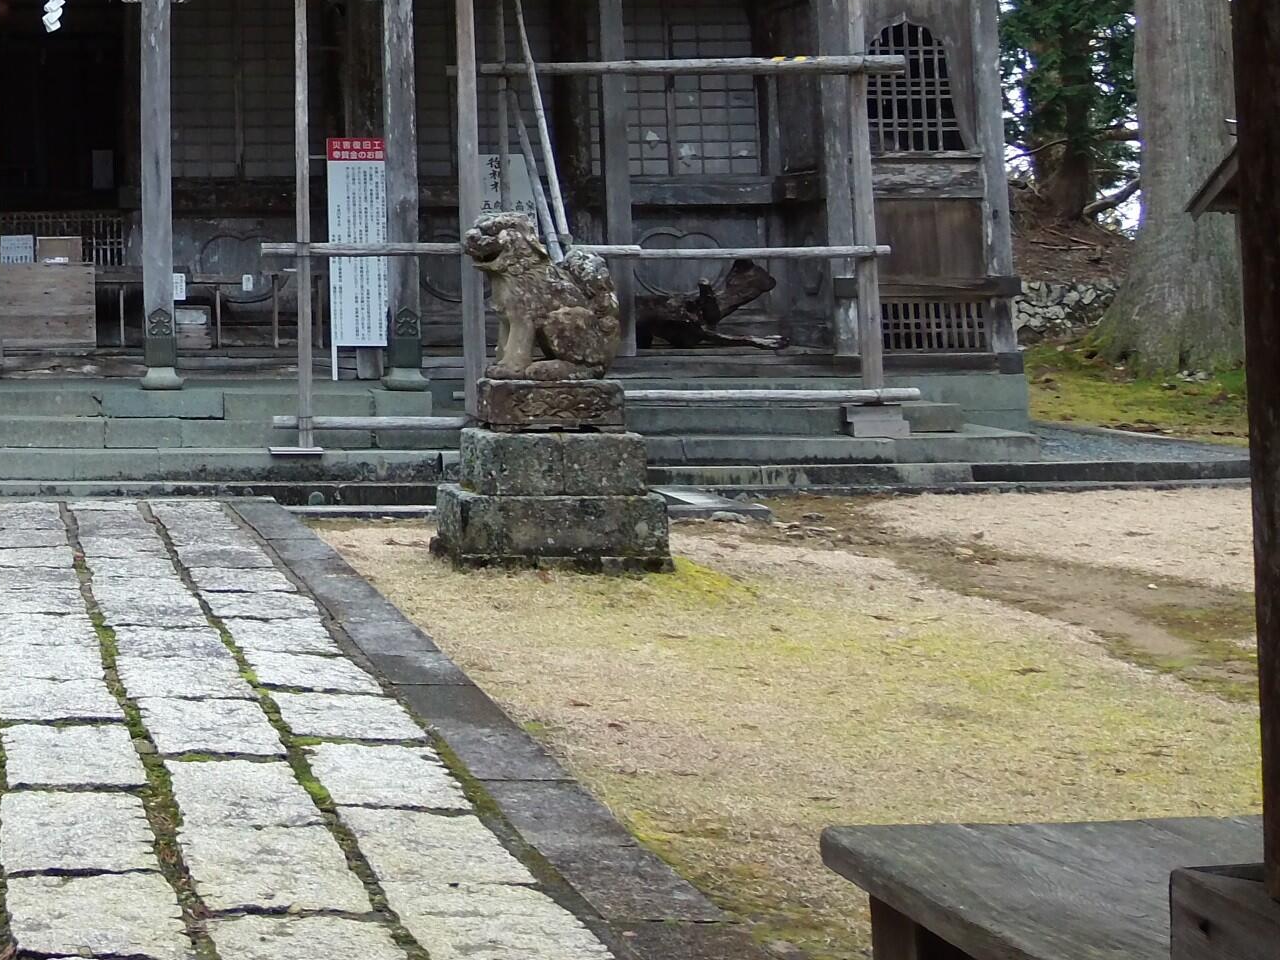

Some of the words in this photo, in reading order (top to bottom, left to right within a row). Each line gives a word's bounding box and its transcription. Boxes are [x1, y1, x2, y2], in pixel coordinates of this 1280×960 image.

[332, 141, 384, 150] 災害復旧工
